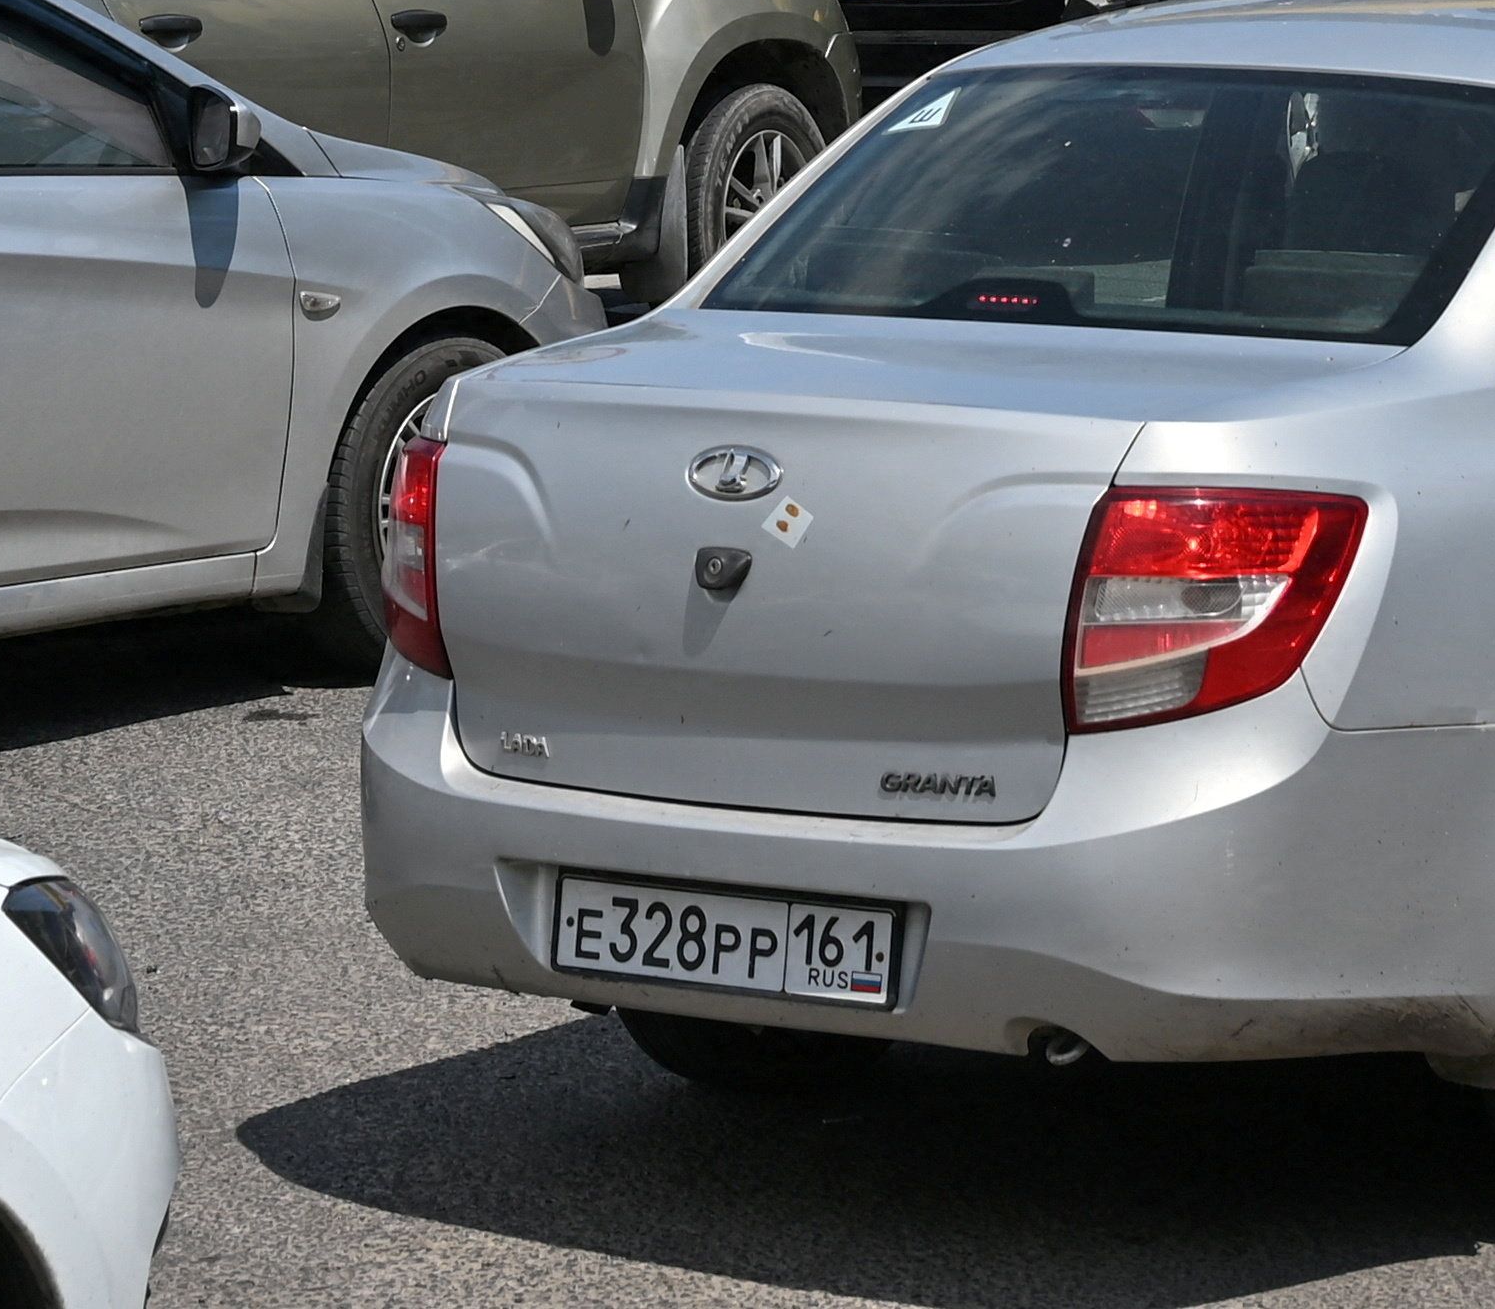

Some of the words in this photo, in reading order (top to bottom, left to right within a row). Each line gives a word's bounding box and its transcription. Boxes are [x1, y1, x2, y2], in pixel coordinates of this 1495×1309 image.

[909, 107, 942, 124] Ш
[500, 730, 551, 759] LADA
[880, 771, 997, 799] GRANTA
[574, 895, 779, 980] Е328РР
[793, 913, 876, 973] 161
[807, 967, 849, 991] RUS
